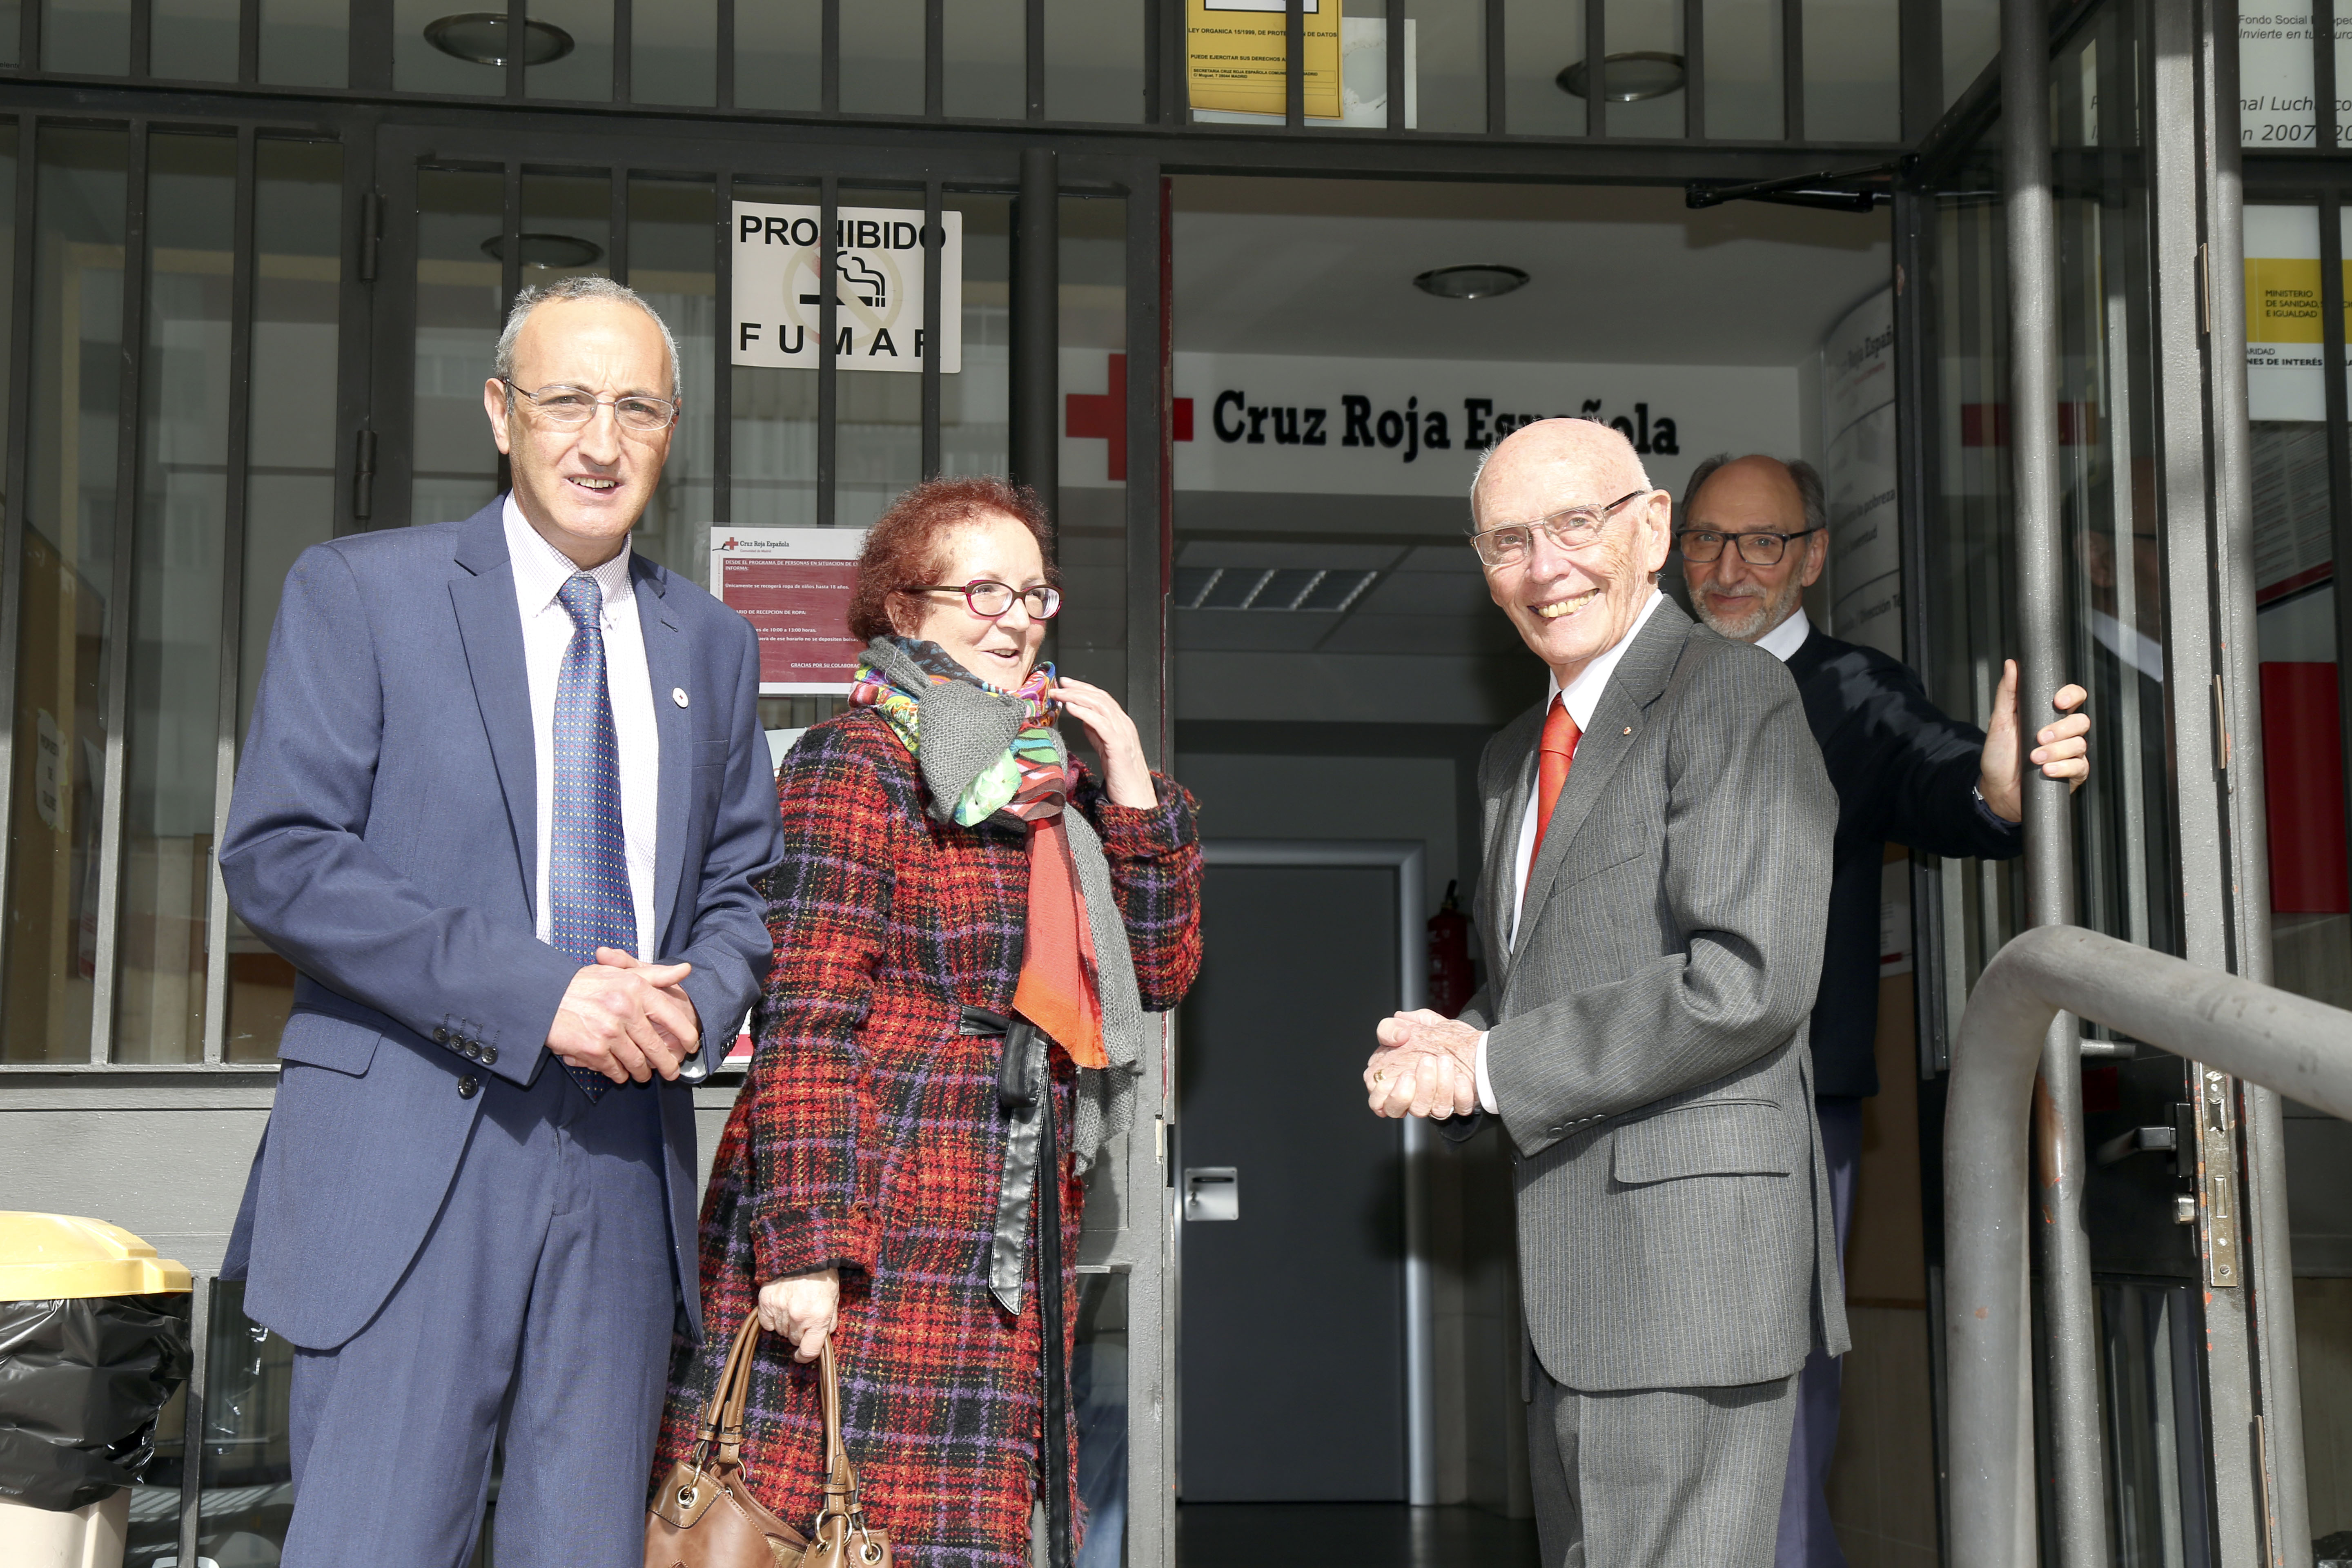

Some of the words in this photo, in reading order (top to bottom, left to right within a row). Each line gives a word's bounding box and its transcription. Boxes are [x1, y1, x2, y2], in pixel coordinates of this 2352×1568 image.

[2239, 14, 2272, 24] Fondo
[2275, 15, 2307, 24] Social
[2239, 29, 2283, 39] Invierte
[2287, 31, 2301, 39] en
[2271, 96, 2316, 111] Luch
[2282, 357, 2323, 366] INTERÉS
[1213, 390, 1326, 445] Cruz
[1342, 394, 1450, 463] Roja
[1464, 398, 1679, 456] Esola
